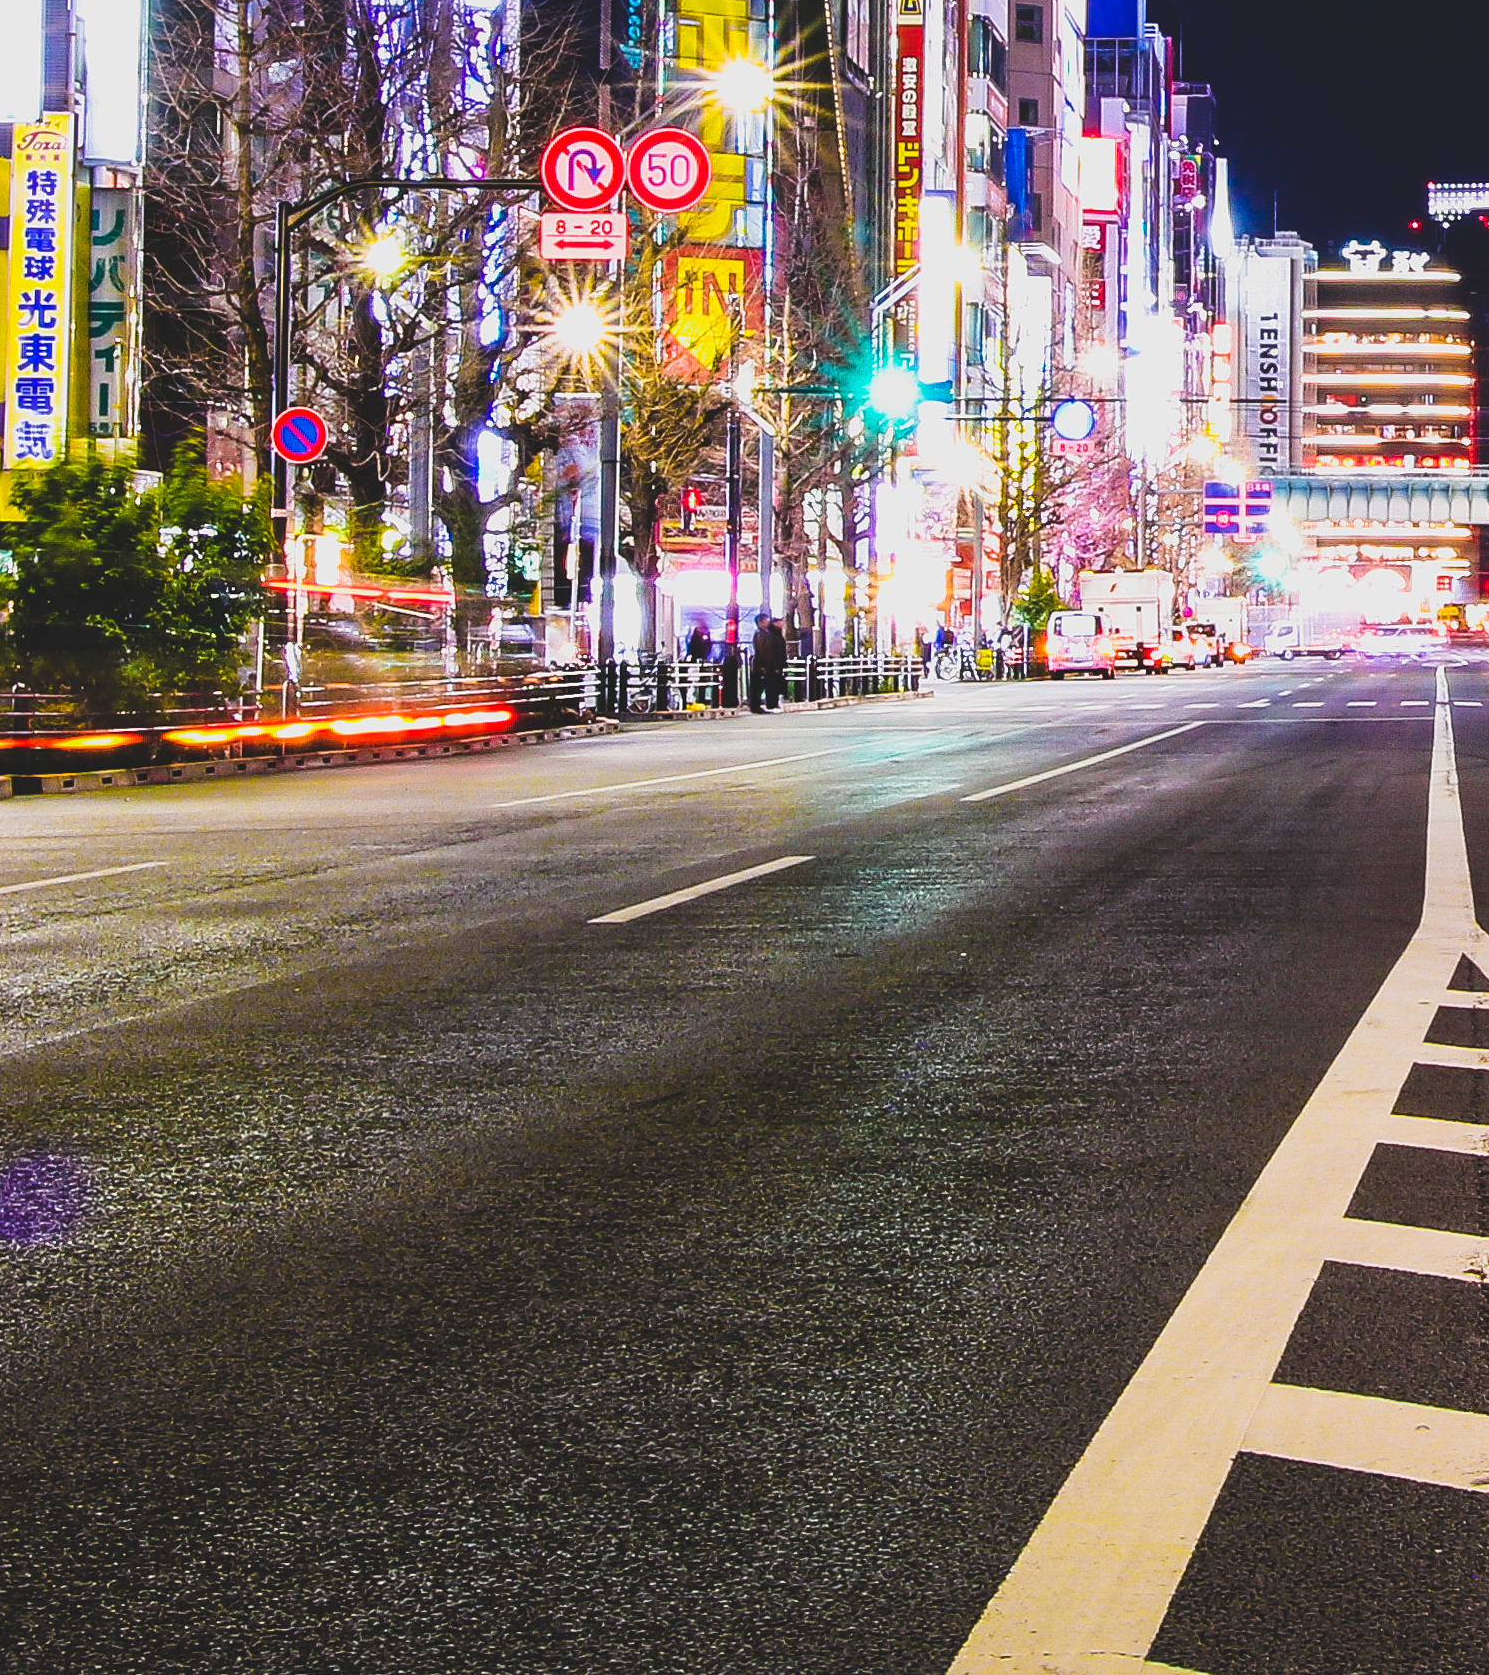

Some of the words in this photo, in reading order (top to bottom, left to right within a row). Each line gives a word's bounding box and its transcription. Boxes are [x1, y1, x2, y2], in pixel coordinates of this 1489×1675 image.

[647, 153, 691, 188] 50
[24, 170, 58, 283] 特殊電球
[87, 207, 126, 418] リバティー
[683, 268, 739, 317] IN
